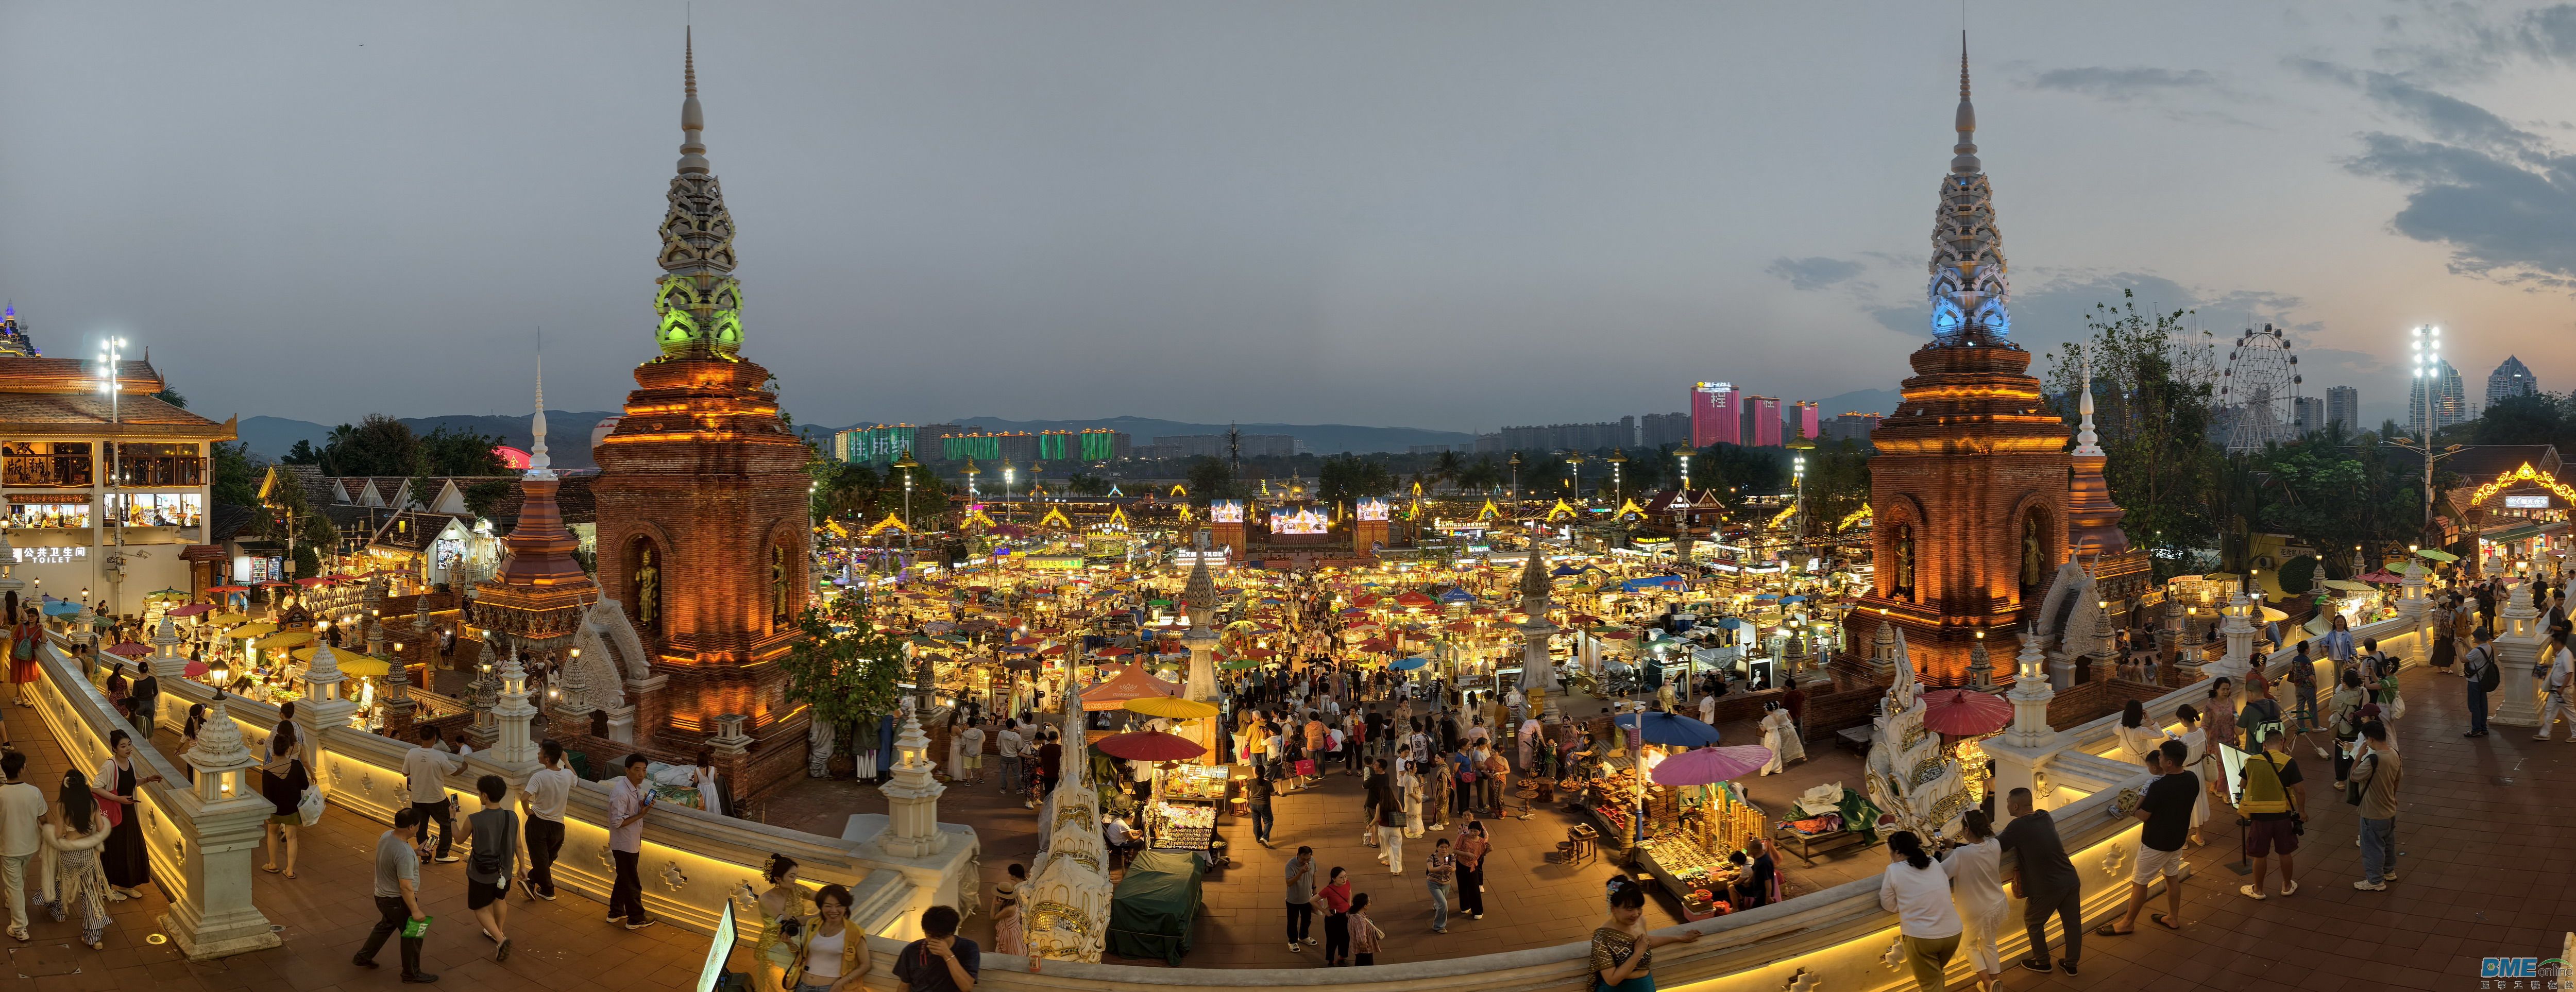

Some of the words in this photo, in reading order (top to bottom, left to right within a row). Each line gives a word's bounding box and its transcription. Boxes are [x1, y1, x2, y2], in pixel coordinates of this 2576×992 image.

[24, 547, 85, 557] 公共卫生间
